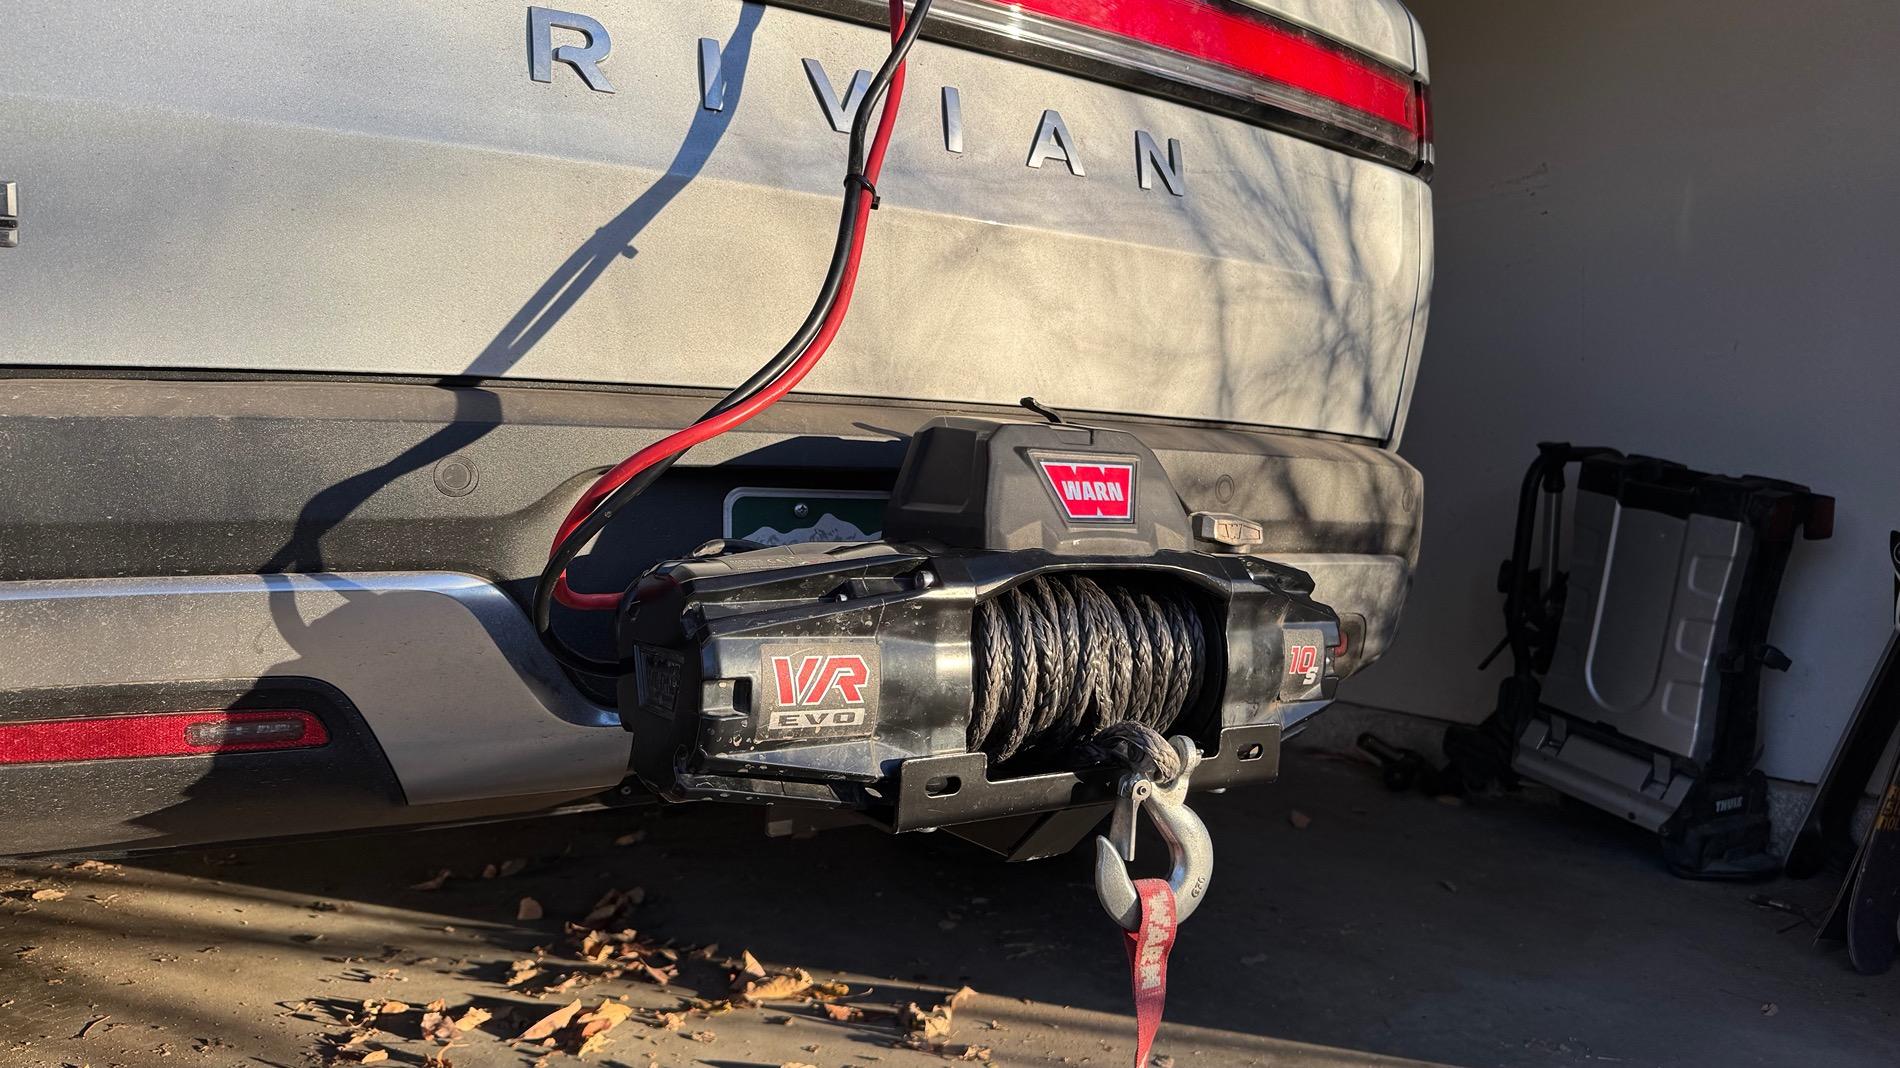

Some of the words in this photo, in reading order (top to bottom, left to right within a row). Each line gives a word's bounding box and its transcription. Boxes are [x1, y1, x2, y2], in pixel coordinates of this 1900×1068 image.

[527, 5, 1185, 196] RIVIAN
[1061, 480, 1125, 502] WARN
[771, 654, 870, 706] VR
[778, 711, 856, 727] EVO
[1139, 891, 1174, 991] WARN
